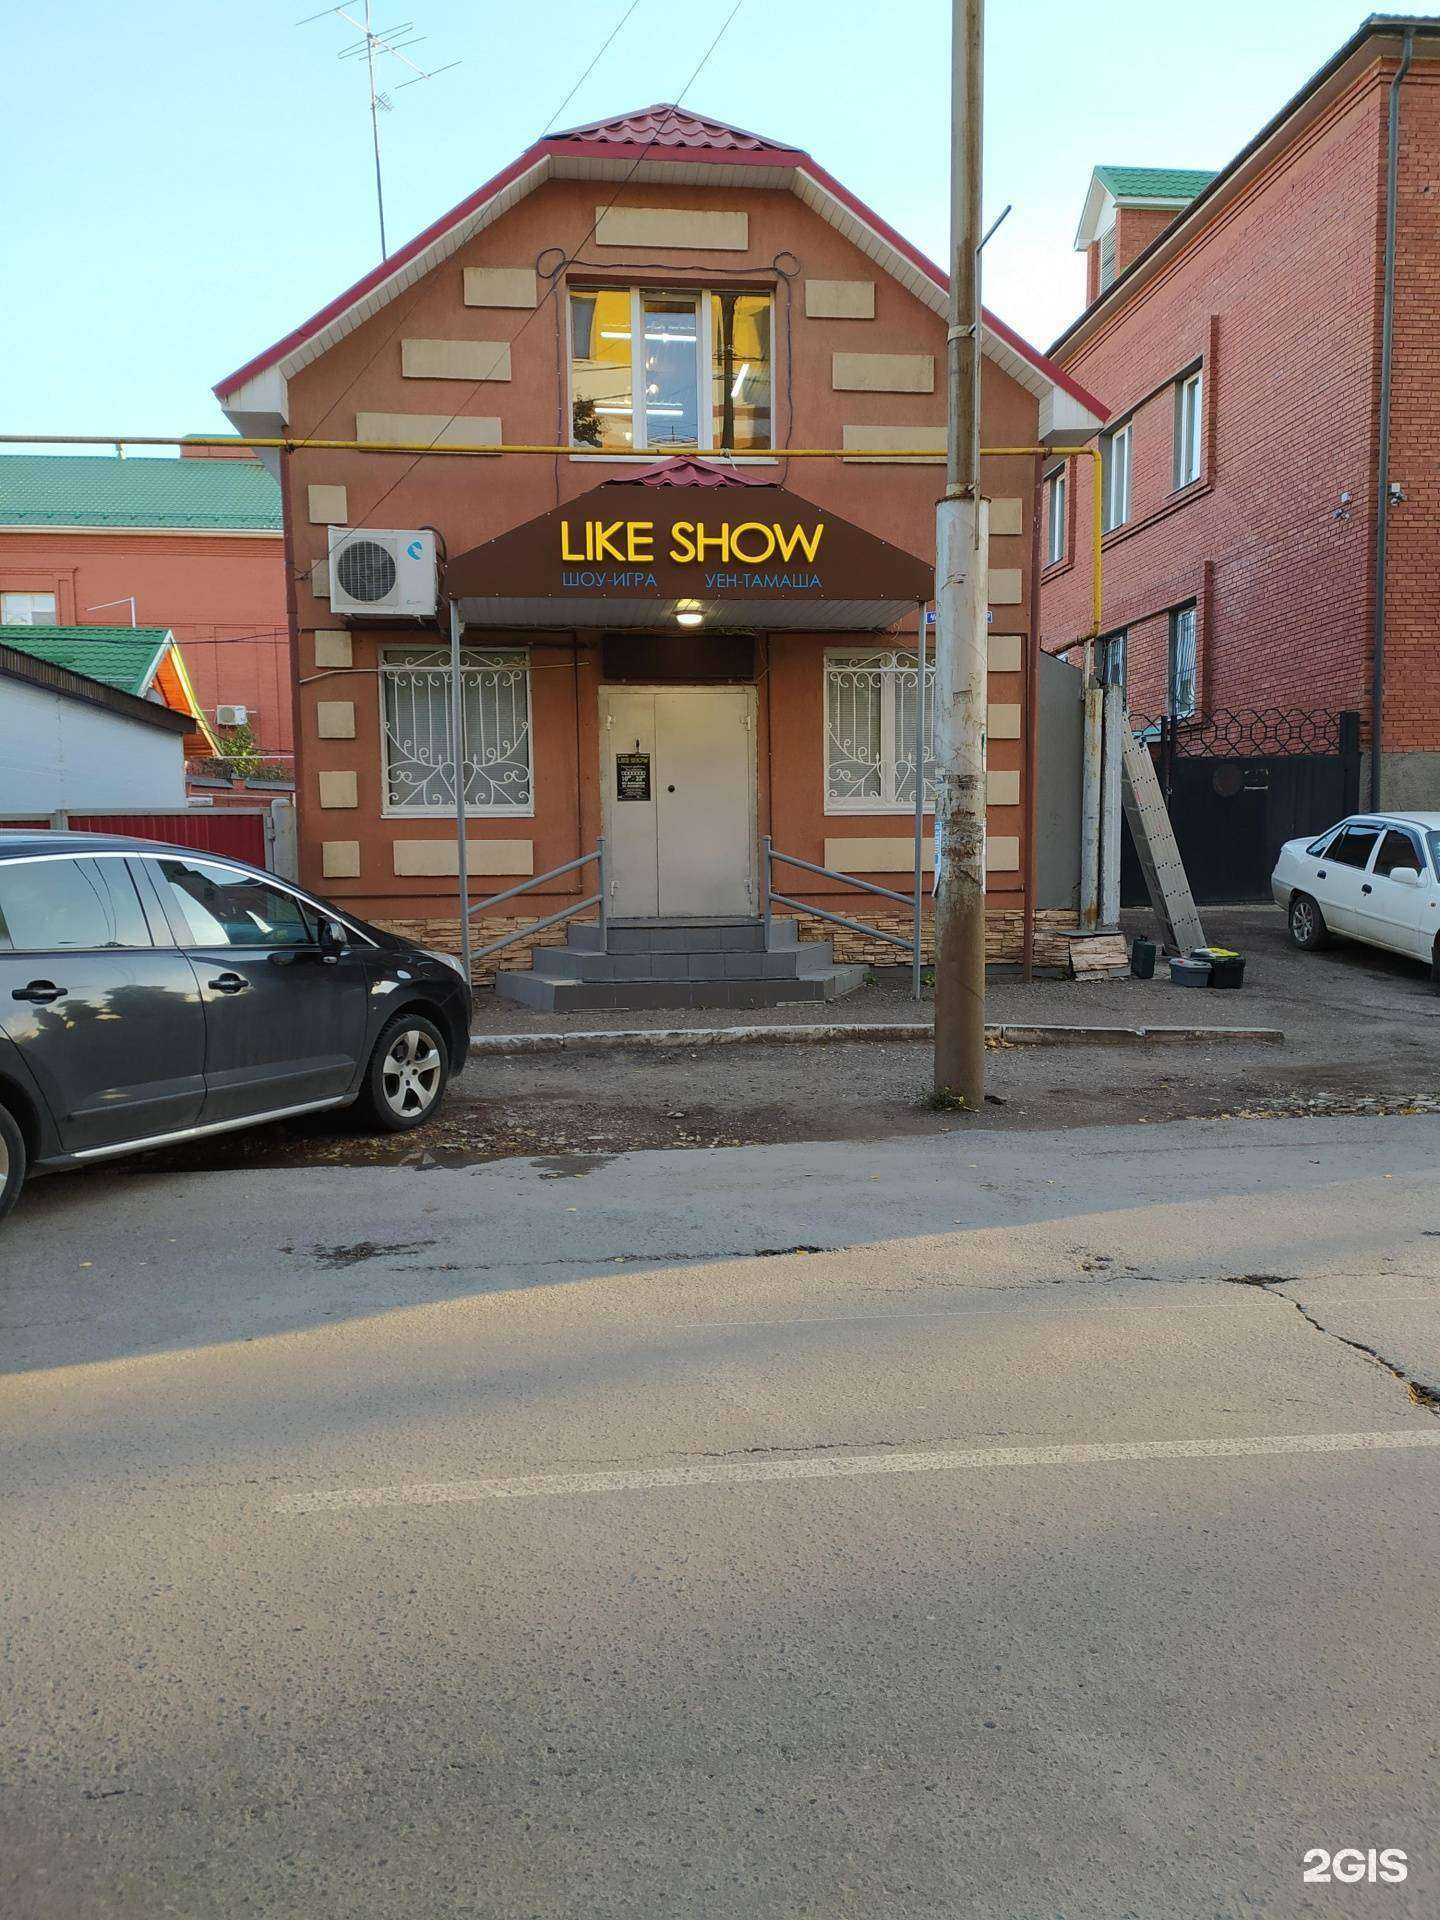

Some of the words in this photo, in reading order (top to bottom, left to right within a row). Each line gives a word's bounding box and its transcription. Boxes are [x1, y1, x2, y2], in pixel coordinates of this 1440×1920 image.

[561, 520, 654, 562] LIKE
[669, 521, 824, 563] SHOW
[562, 571, 657, 587] ШОУ-ИГРА
[704, 573, 823, 588] УЕН-ТАМАША
